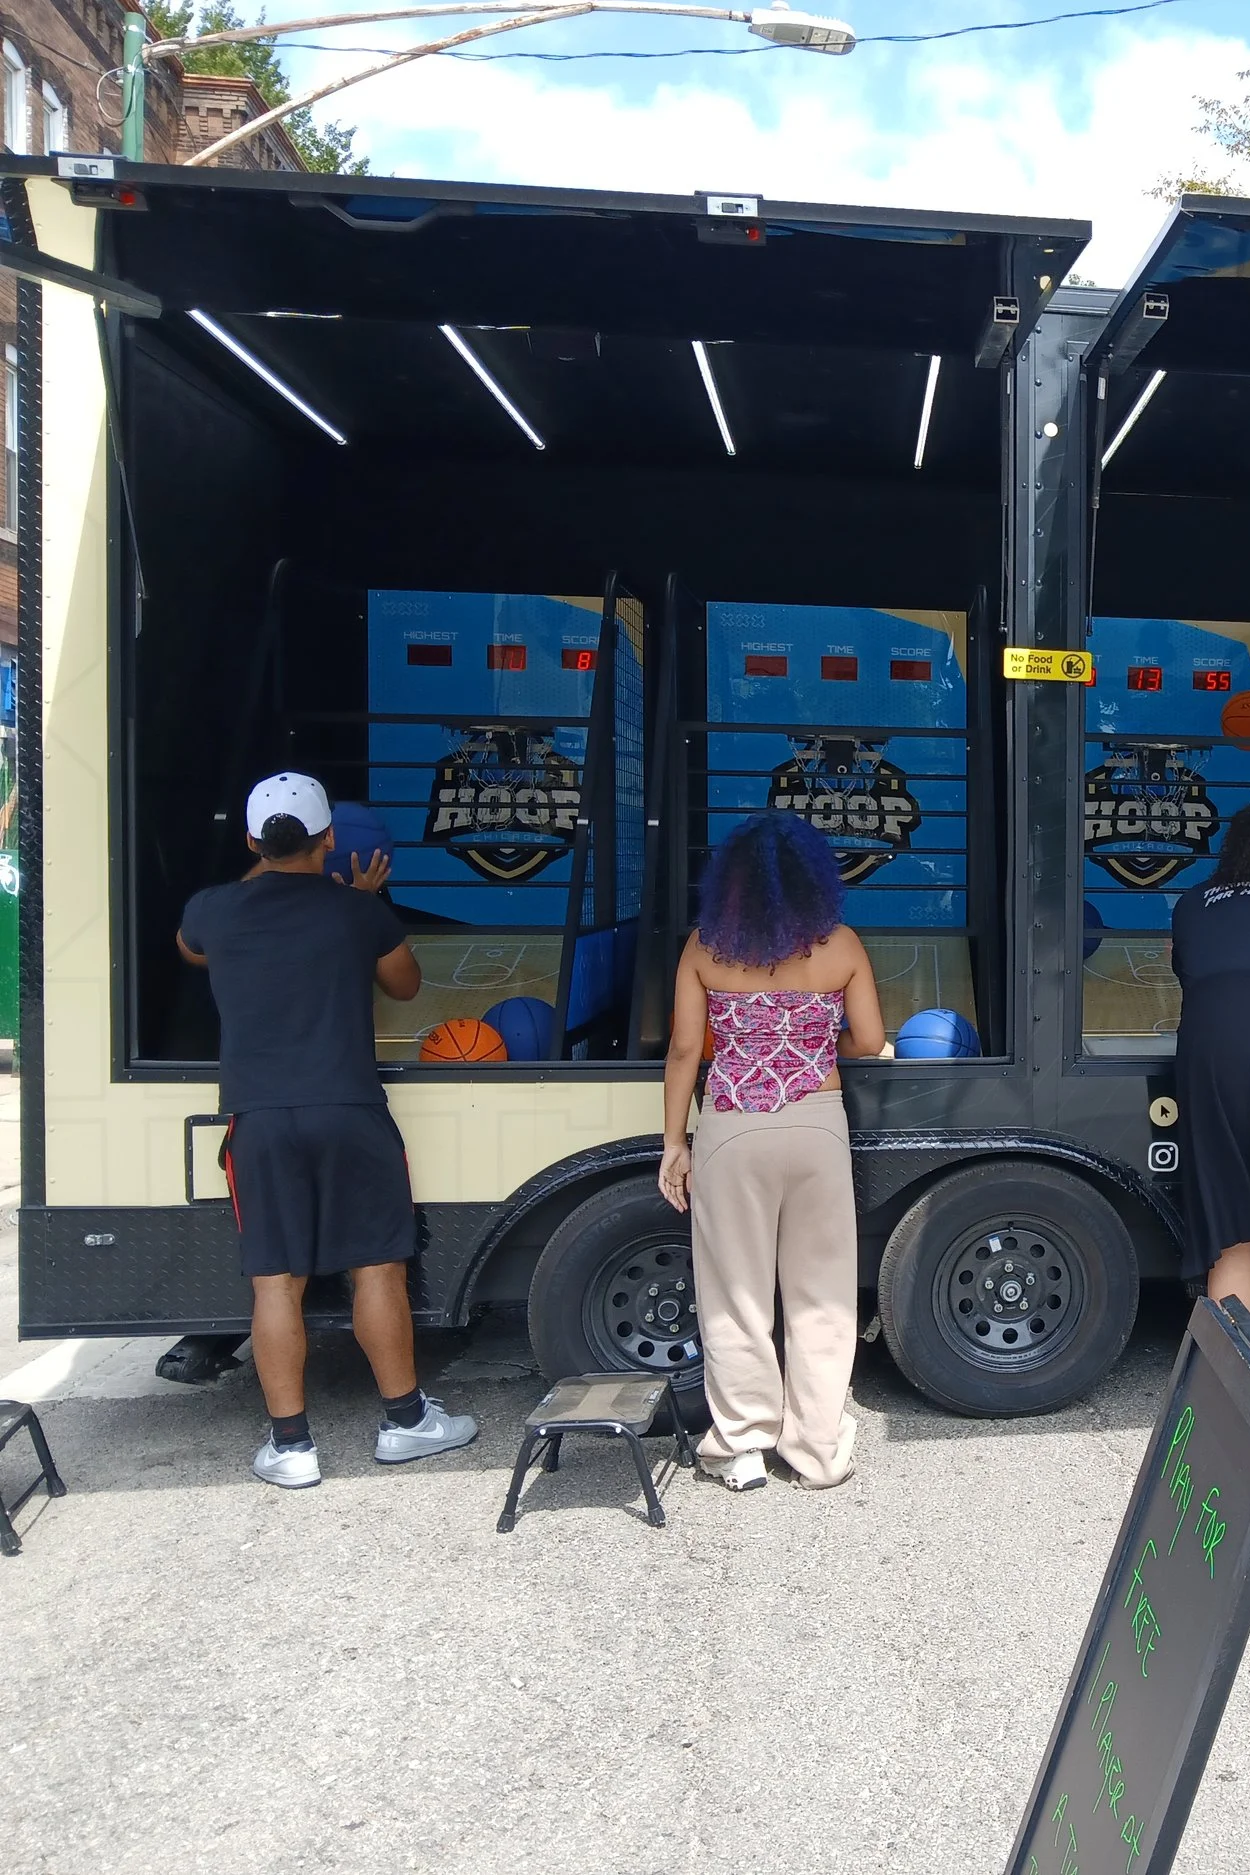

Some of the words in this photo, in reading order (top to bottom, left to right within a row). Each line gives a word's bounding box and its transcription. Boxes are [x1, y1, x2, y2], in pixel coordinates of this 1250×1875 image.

[404, 631, 458, 641] HIGHEST
[494, 633, 523, 643] TIME
[562, 635, 600, 645] SCOR
[741, 642, 793, 652] HIGHEST
[827, 644, 854, 654] TIME
[891, 647, 932, 657] SCORE
[577, 652, 591, 670] 8
[1010, 654, 1025, 663] No
[1028, 655, 1053, 664] Food
[1133, 656, 1159, 665] TIME
[1193, 658, 1232, 667] SCORE
[1011, 665, 1022, 673] or
[1026, 665, 1052, 674] Drink
[1136, 669, 1161, 690] 13
[1207, 673, 1230, 690] 55
[433, 788, 581, 833] HOOP
[1084, 801, 1213, 841] HOOP
